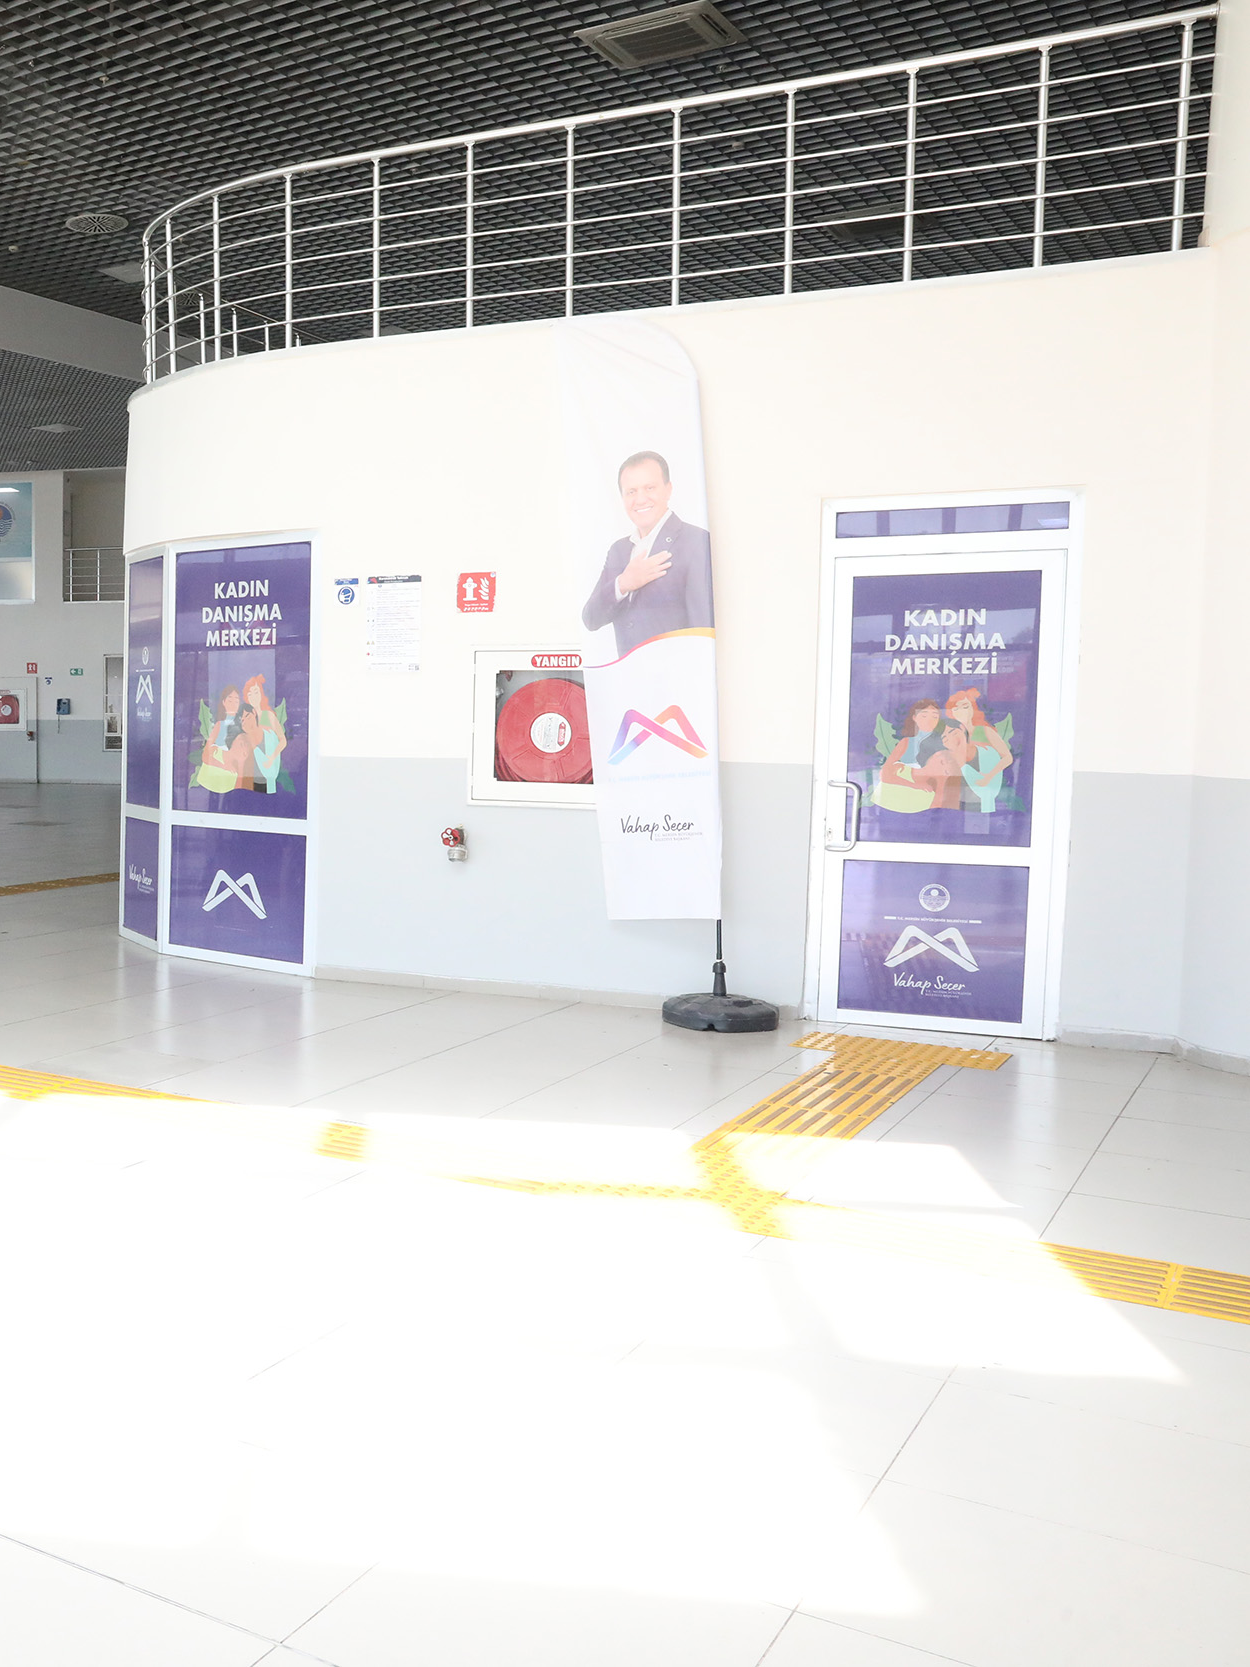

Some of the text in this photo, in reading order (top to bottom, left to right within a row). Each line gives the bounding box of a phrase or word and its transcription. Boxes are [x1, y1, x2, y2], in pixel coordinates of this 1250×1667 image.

[214, 579, 269, 599] KADIN
[202, 604, 282, 628] DANIŞMA
[904, 608, 987, 627] KADIN
[205, 622, 277, 647] MERKEZİ
[884, 632, 1006, 656] DANIŞMA
[534, 656, 580, 667] YANGIN
[890, 651, 998, 675] MERKEZİ
[620, 814, 660, 841] Vahap
[893, 972, 932, 995] Vahap
